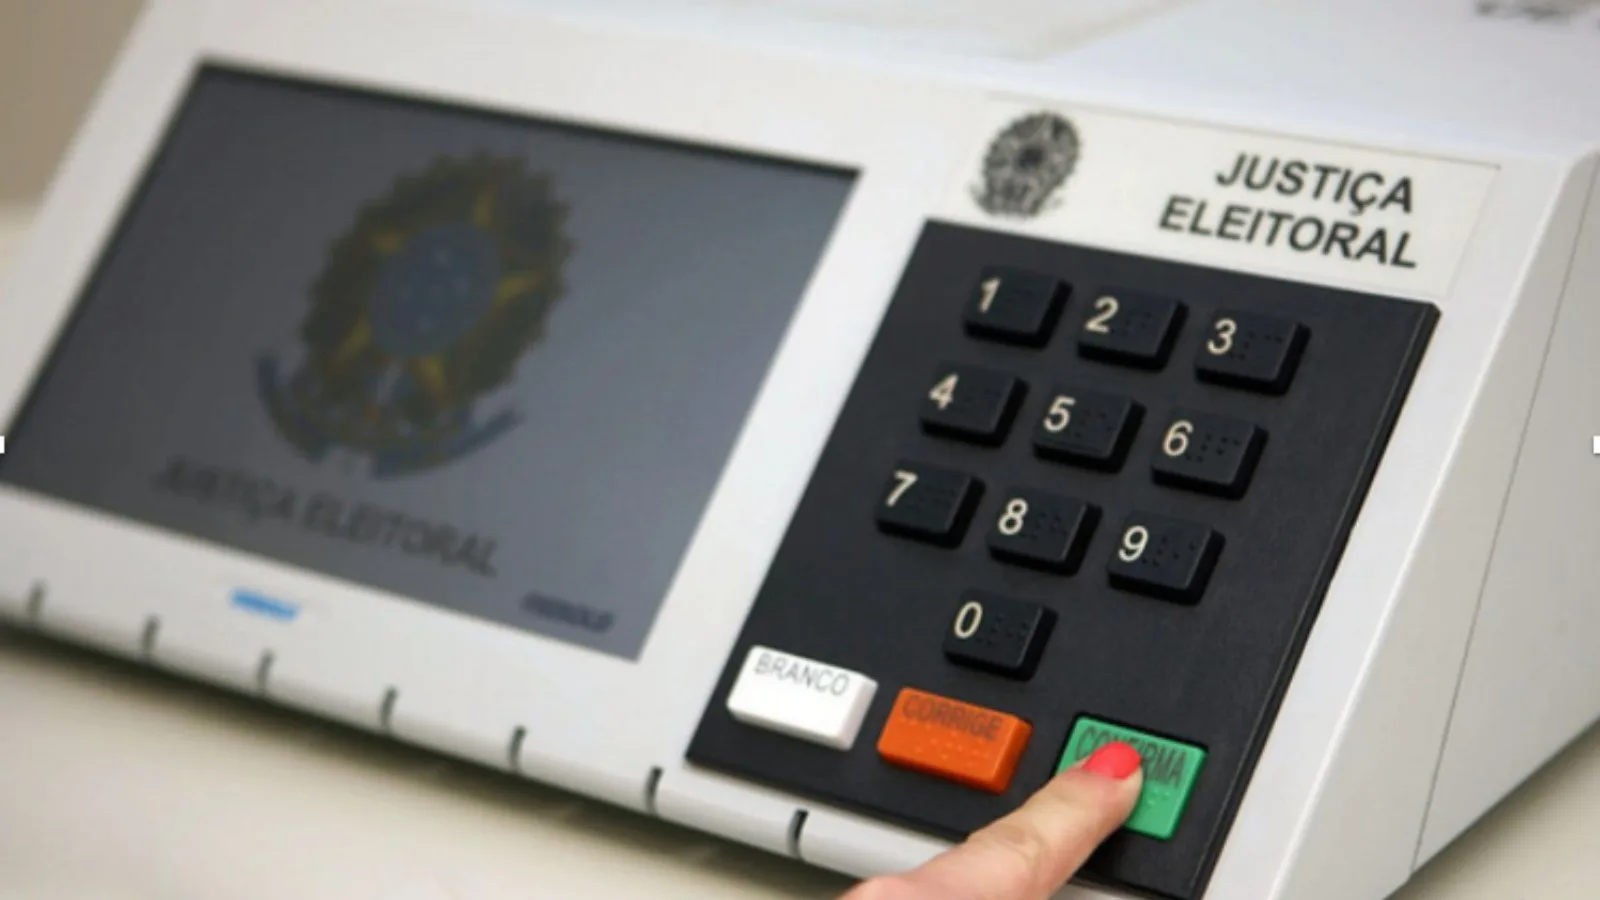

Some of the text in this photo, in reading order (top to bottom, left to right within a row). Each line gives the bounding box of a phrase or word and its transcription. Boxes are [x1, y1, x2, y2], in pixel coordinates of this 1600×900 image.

[1215, 153, 1414, 216] JUSTIÇA
[1158, 194, 1417, 270] ELEITORAL
[981, 279, 1000, 312] 1
[1085, 296, 1119, 333] 2
[1207, 318, 1237, 355] 3
[929, 374, 959, 410] 4
[1043, 396, 1075, 432] 5
[1162, 420, 1194, 457] 6
[886, 470, 918, 506] 7
[998, 498, 1029, 536] 8
[1118, 525, 1149, 562] 9
[953, 601, 983, 639] 0
[754, 652, 850, 697] BRANCO
[902, 695, 1004, 741] CORRIGE
